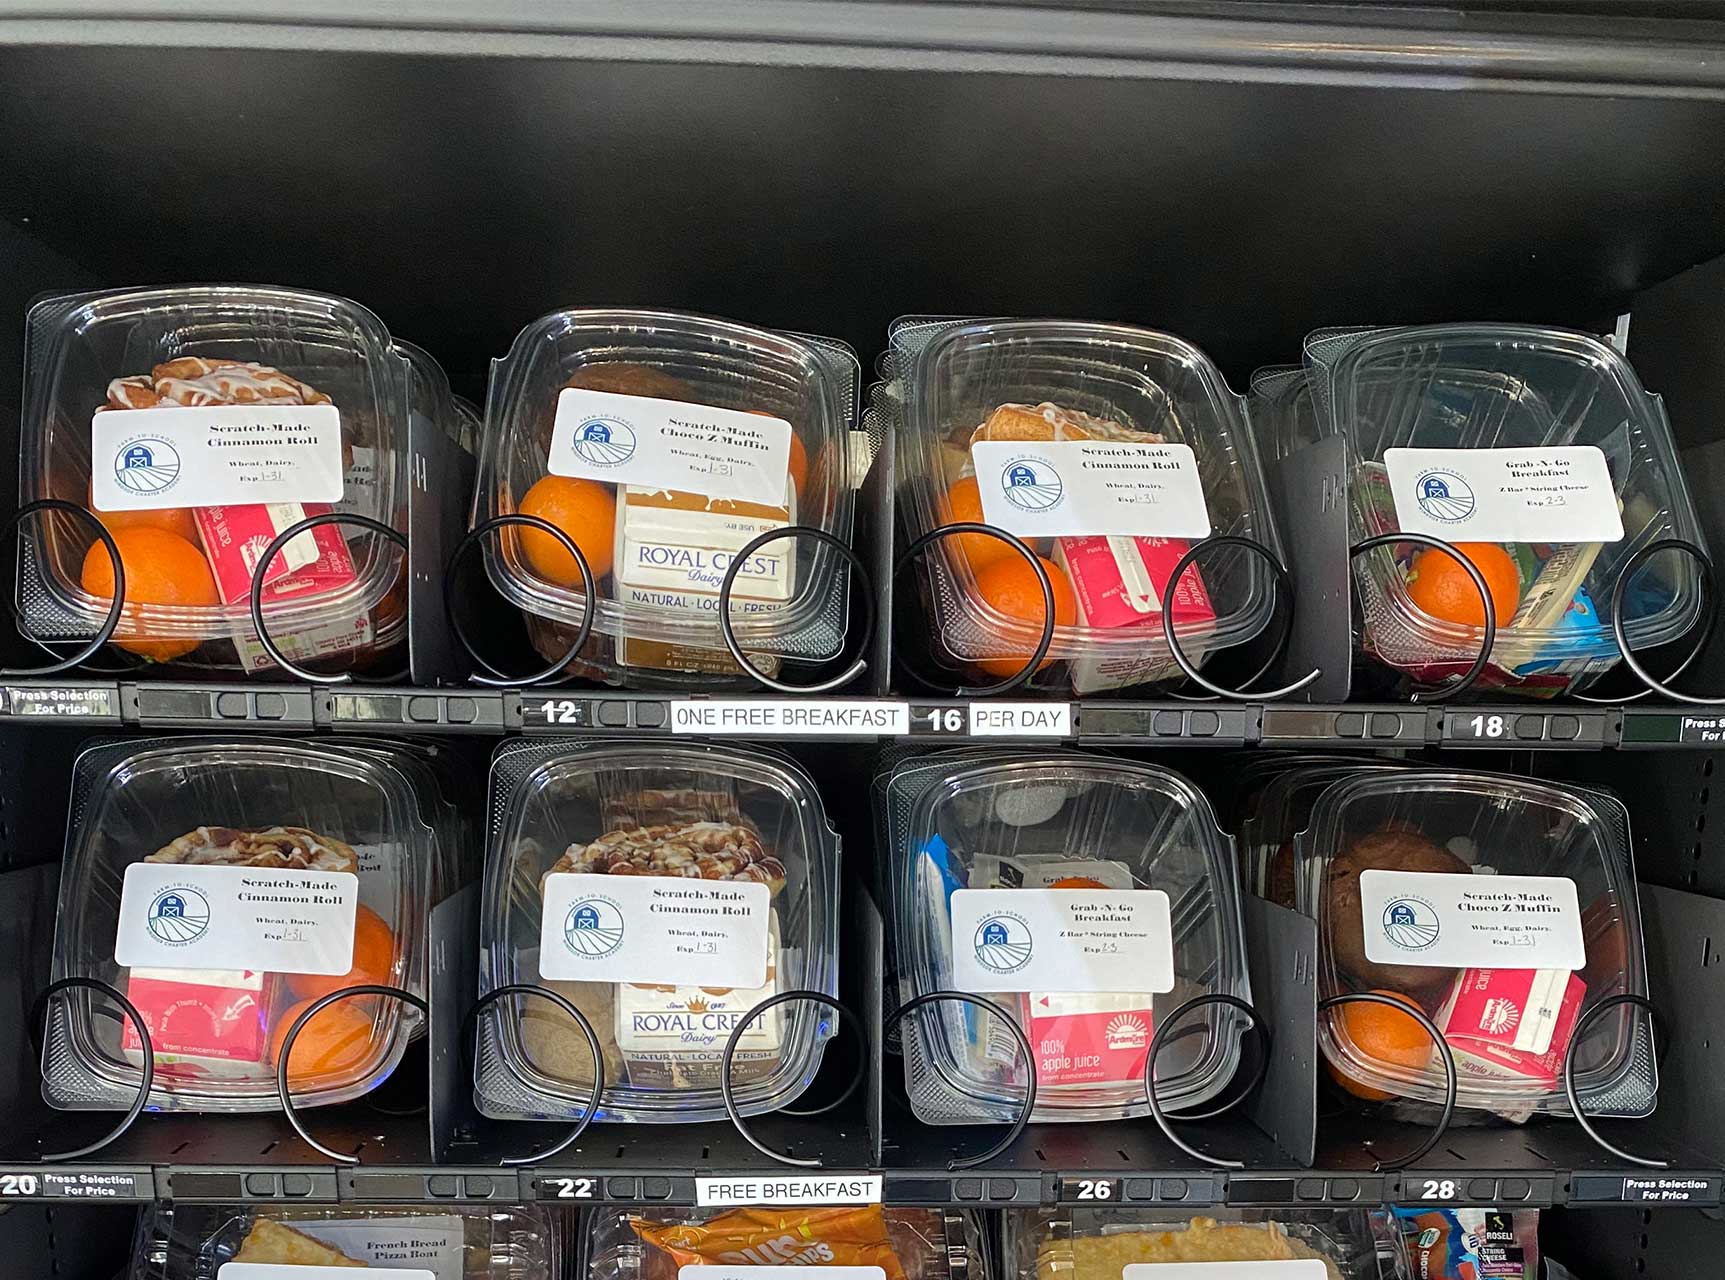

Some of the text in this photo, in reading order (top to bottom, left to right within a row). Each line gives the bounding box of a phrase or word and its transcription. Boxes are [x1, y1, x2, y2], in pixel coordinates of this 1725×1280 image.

[209, 423, 311, 433] Scratch-Made
[669, 418, 763, 442] Scratch-Made
[207, 436, 318, 447] Cinnamon Roll
[660, 427, 769, 451] Choco Z Muffin
[1081, 448, 1171, 457] Scratch-Made
[1082, 461, 1180, 470] Cinnamon Roll
[1511, 469, 1569, 478] Breakfast
[638, 545, 707, 568] ROYAL
[688, 570, 724, 587] Dairy
[14, 690, 107, 701] Press Selection
[35, 703, 89, 714] For Price
[541, 701, 577, 722] 12
[722, 708, 776, 726] FREE
[782, 708, 900, 727] BREAKFAST
[927, 709, 961, 731] 16
[976, 710, 1062, 728] PER DAY
[1684, 718, 1716, 729] Press
[1470, 715, 1503, 738] 18
[1701, 730, 1721, 741] For
[241, 879, 337, 890] Scratch-Made
[237, 892, 343, 905] Cinnamon Roll
[652, 889, 745, 901] Scratch-Made
[1463, 892, 1552, 902] Scratch-Made
[649, 903, 751, 916] Cinnamon Roll
[1457, 903, 1561, 913] Choco Z Muffin
[1074, 914, 1131, 922] Breakfast
[633, 1014, 698, 1032] ROYAL
[680, 1031, 716, 1046] Dairy
[1040, 1039, 1065, 1055] 100%
[1041, 1053, 1101, 1073] apple juice
[0, 1175, 36, 1194] 20
[44, 1174, 134, 1185] Press Selection
[1626, 1179, 1708, 1189] Press Selection
[64, 1185, 116, 1197] For Price
[557, 1178, 592, 1197] 22
[708, 1181, 874, 1200] FREE BREAKFAST
[1077, 1180, 1111, 1200] 26
[1421, 1180, 1455, 1200] 28
[1642, 1190, 1690, 1200] For Price
[1486, 1231, 1513, 1241] ROSELI
[367, 1239, 447, 1250] French Bread
[374, 1250, 438, 1260] Pizza Boat
